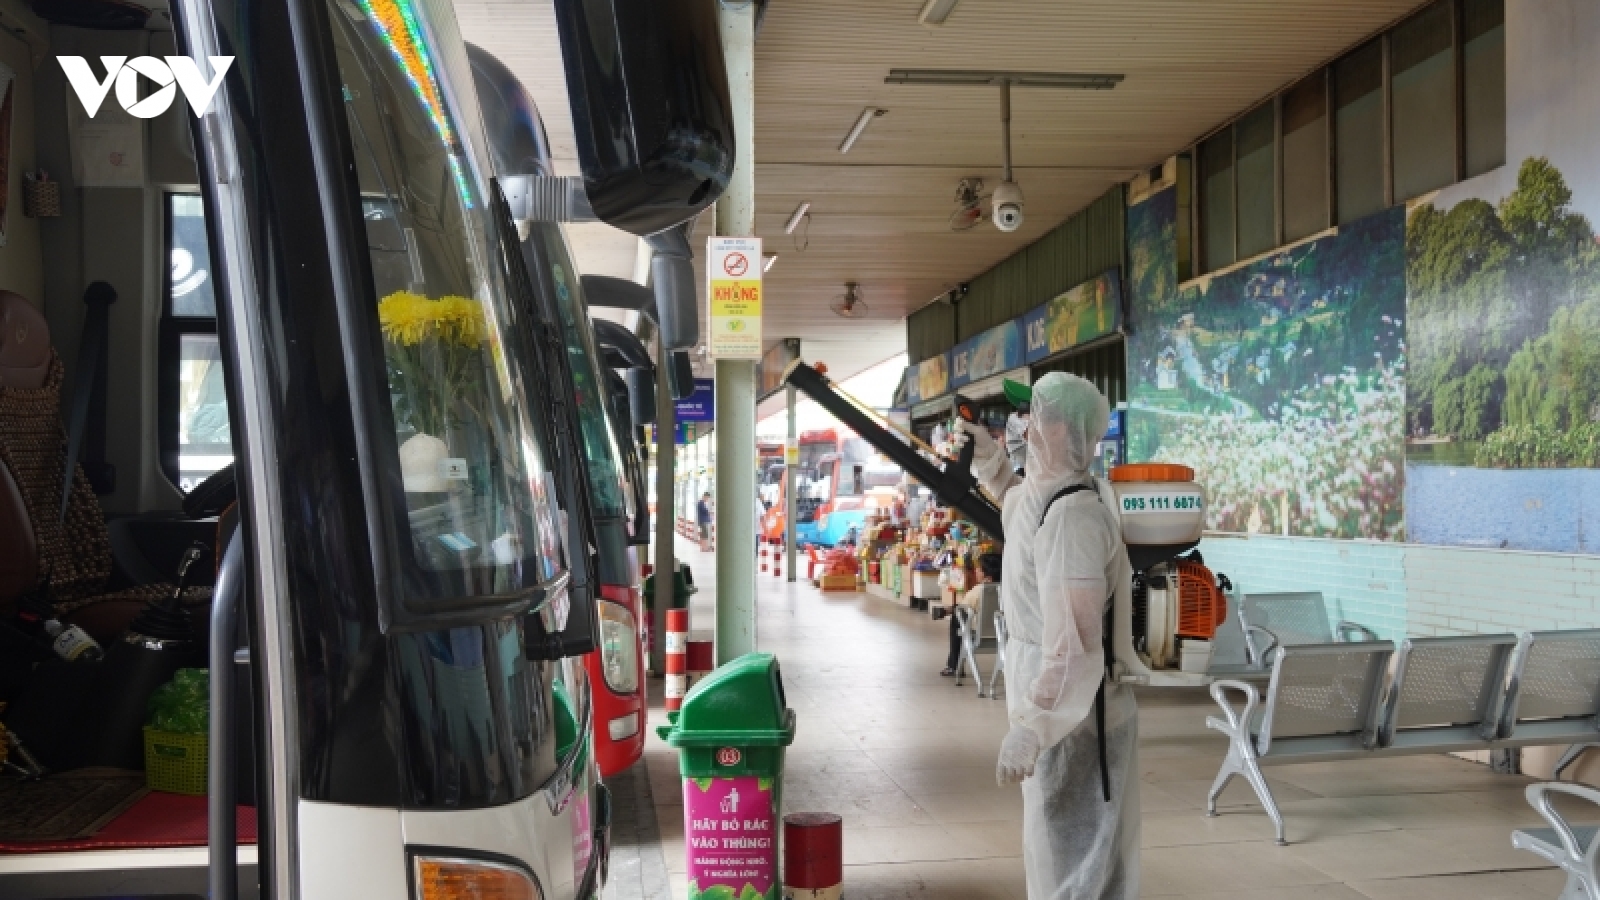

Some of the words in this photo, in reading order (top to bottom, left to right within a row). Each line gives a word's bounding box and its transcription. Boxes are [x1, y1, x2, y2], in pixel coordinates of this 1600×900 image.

[1123, 497, 1146, 510] 093
[1149, 496, 1170, 510] 111
[693, 818, 718, 830] HÃY
[721, 816, 740, 830] BỎ
[743, 818, 769, 830] RÁC
[691, 836, 718, 848] VÀO
[721, 836, 771, 848] THÙNG!
